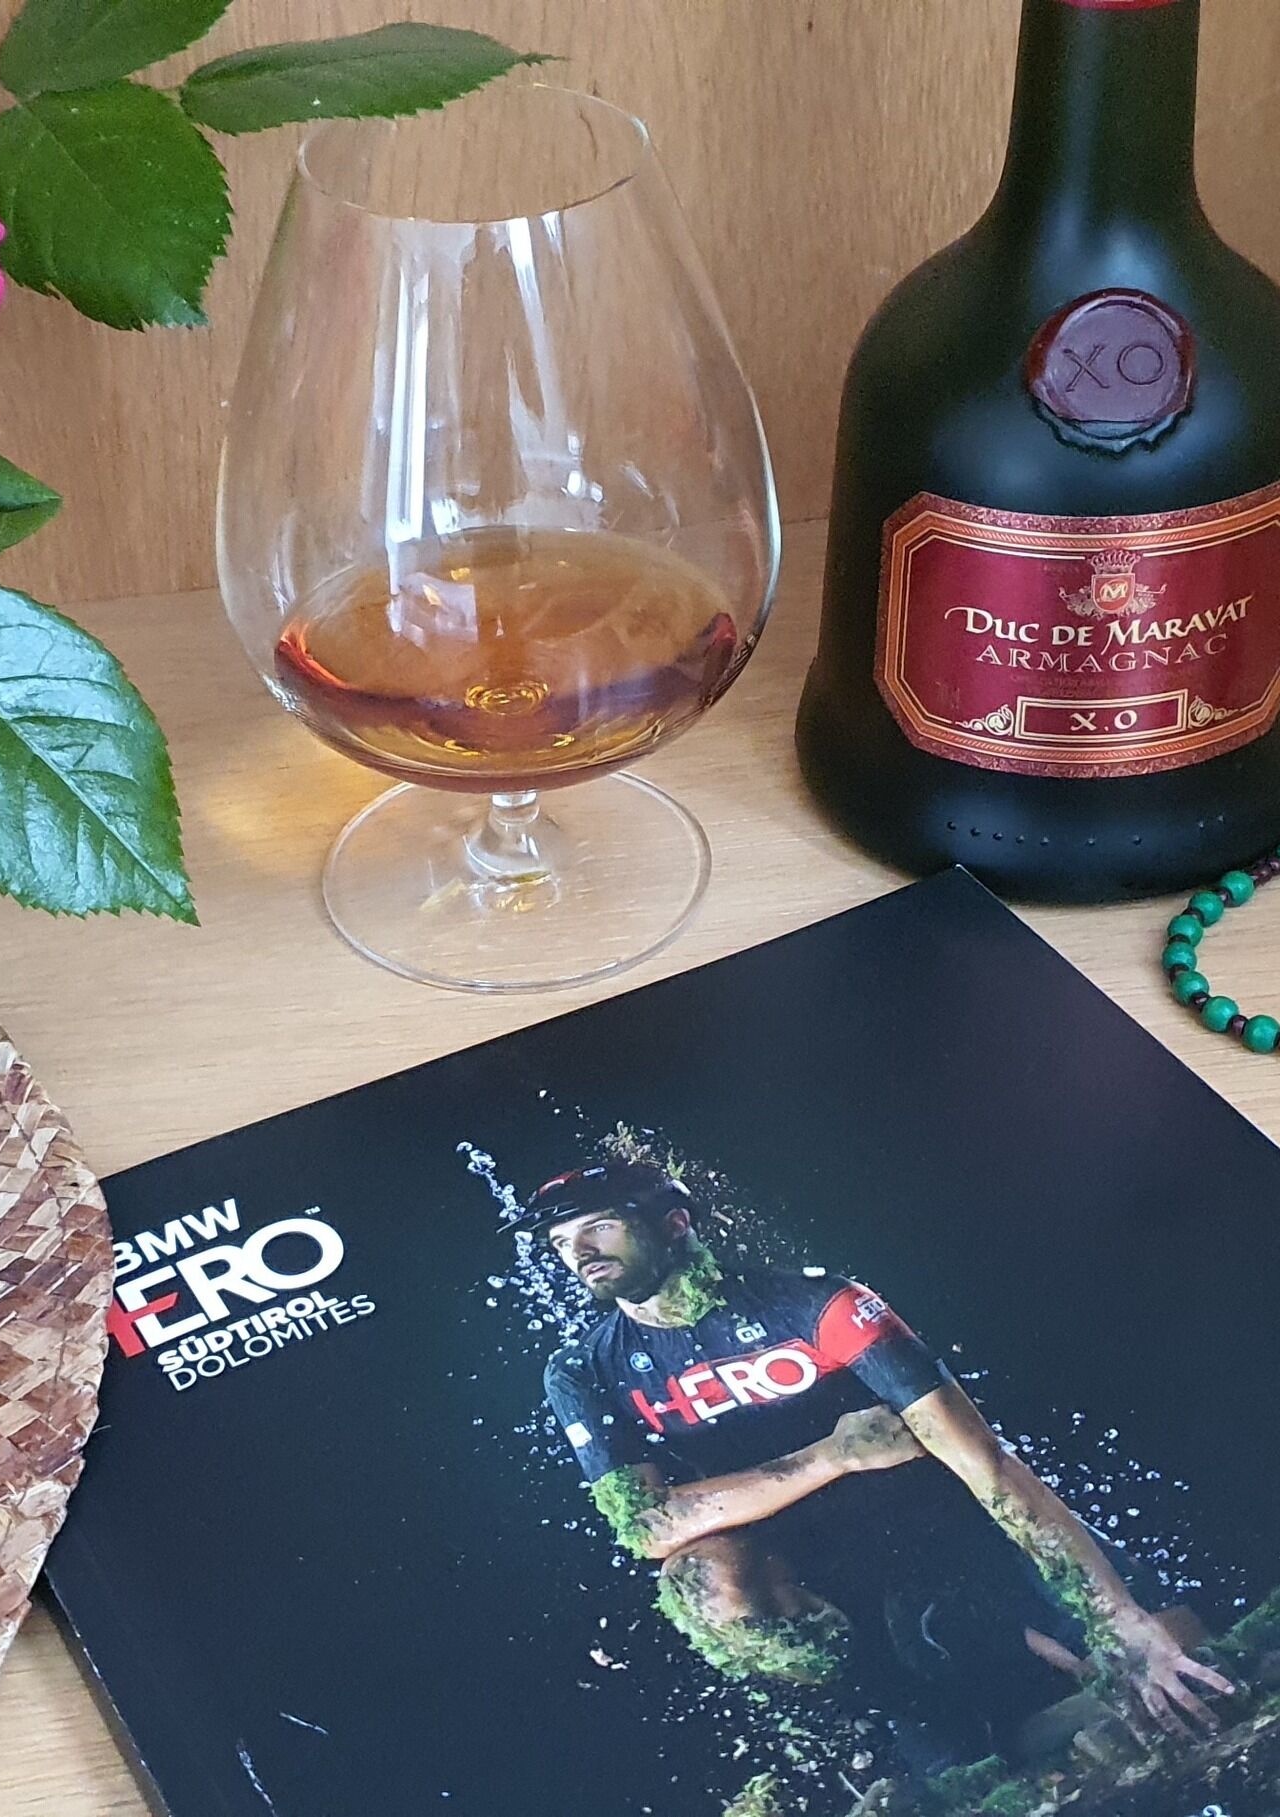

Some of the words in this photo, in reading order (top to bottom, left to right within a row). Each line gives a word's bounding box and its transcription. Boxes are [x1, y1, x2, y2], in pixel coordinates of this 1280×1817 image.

[976, 633, 1228, 673] ARMAGNAC
[1051, 625, 1094, 646] DE
[1101, 594, 1254, 655] MARAVAT
[114, 1198, 241, 1276] BMW
[157, 1290, 339, 1374] SÜDTIROL
[168, 1293, 376, 1392] DOLOMITES
[631, 1348, 818, 1432] HERO
